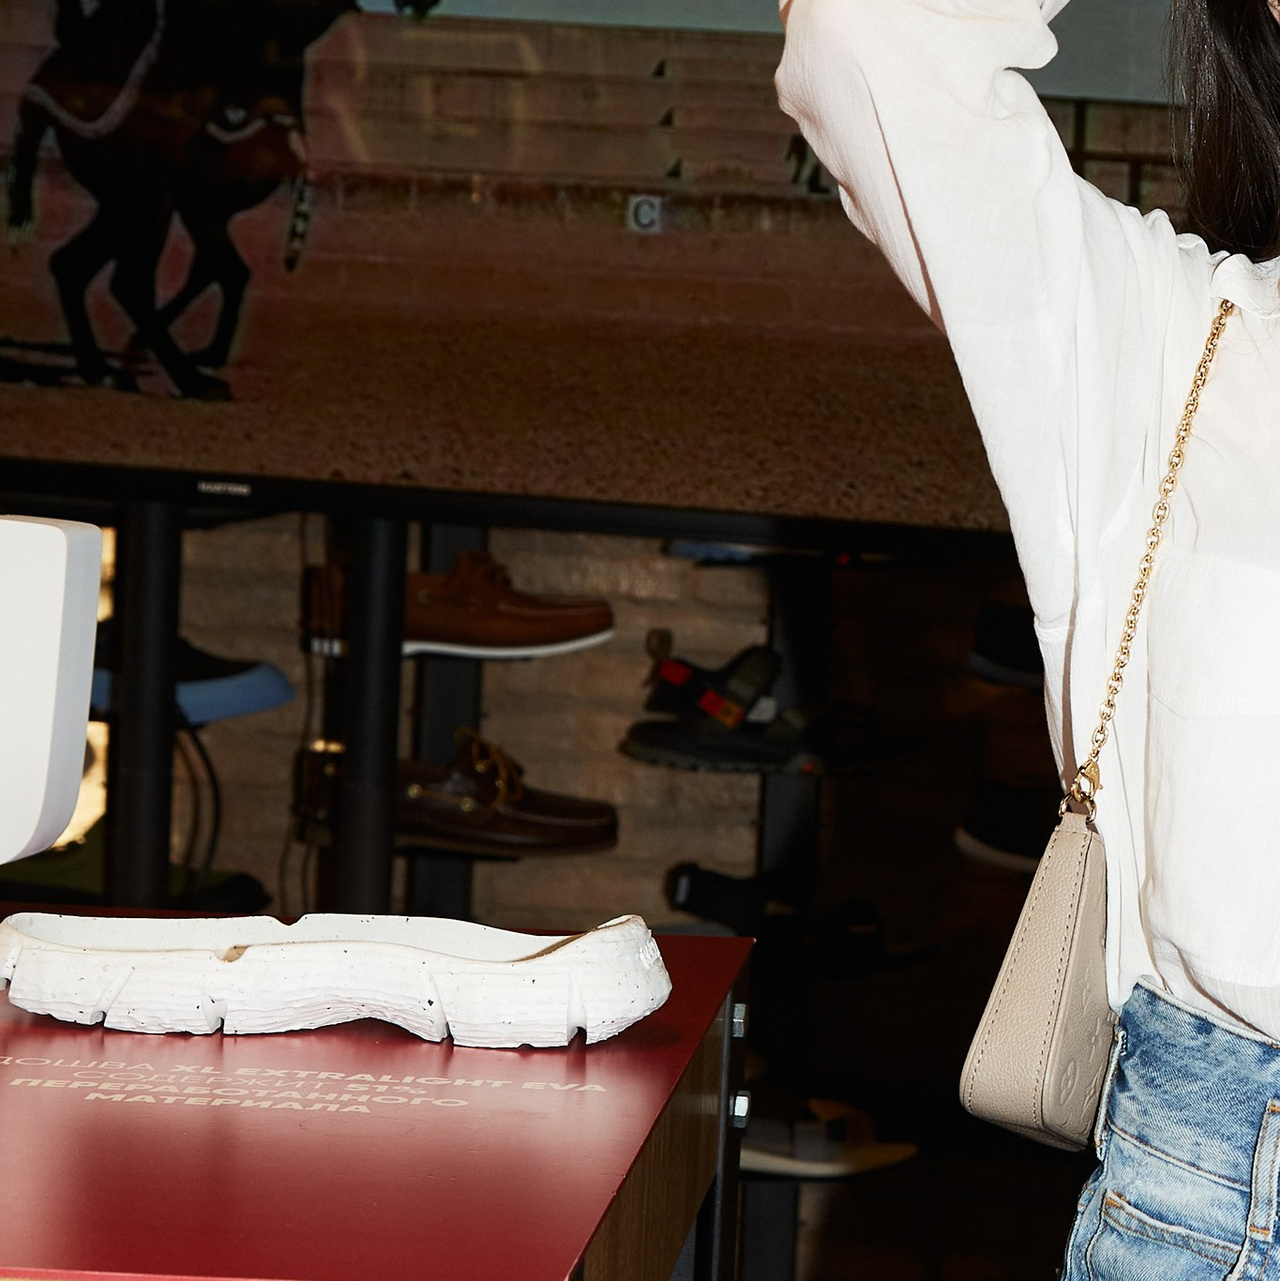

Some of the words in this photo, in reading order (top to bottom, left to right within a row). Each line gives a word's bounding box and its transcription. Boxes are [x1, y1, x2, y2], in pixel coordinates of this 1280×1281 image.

[73, 1070, 333, 1090] СОДЕРЖИТ
[342, 1083, 428, 1096] 51%
[168, 1064, 222, 1074] XL
[234, 1067, 512, 1089] EXTRALIGHT
[520, 1081, 607, 1093] EVA
[9, 1078, 470, 1108] ПЕРЕРАБОТАННОГО
[84, 1091, 372, 1114] МАТЕРИАЛА
